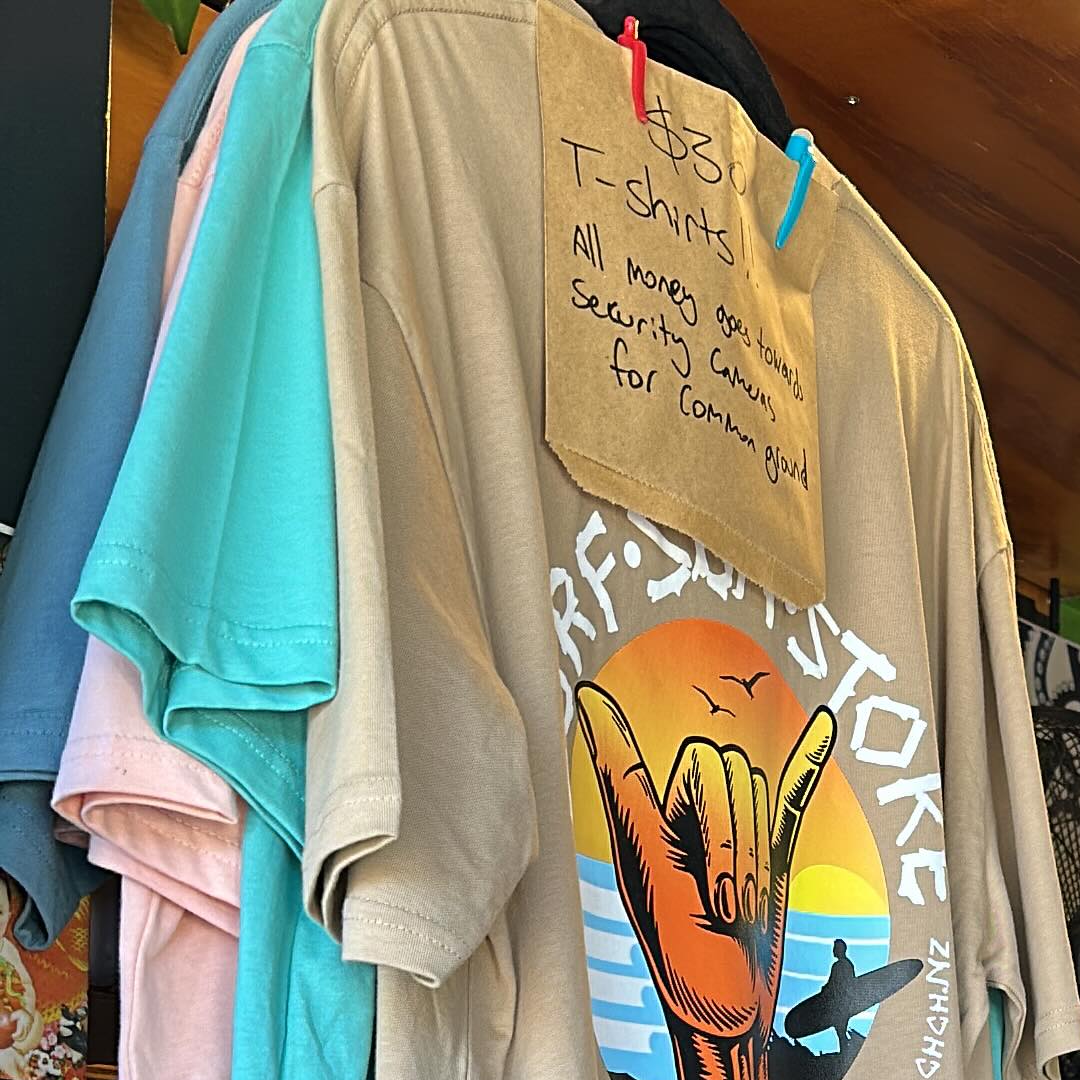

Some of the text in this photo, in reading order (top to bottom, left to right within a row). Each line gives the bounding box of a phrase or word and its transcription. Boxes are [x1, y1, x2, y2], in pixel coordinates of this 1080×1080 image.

[647, 95, 747, 196] $30
[571, 278, 691, 378] Security
[573, 223, 604, 271] All
[628, 257, 697, 326] money
[717, 305, 750, 347] goes
[610, 338, 657, 392] for
